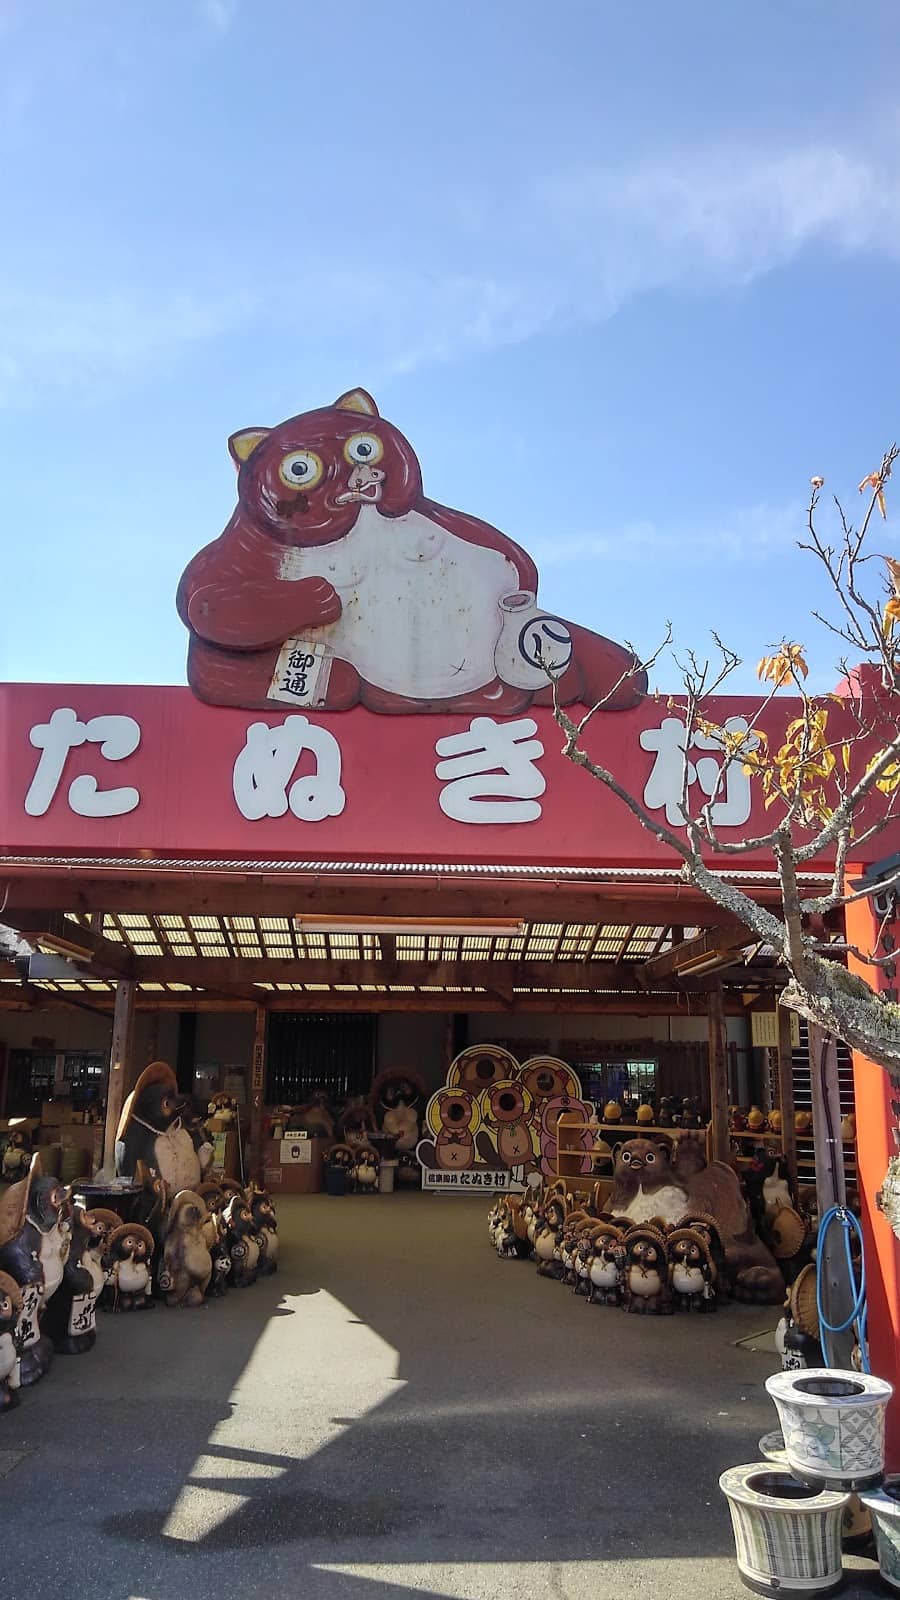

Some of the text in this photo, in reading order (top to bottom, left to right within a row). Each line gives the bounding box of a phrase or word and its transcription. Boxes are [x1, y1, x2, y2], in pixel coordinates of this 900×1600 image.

[279, 650, 315, 697] 御通
[24, 706, 761, 827] たぬき村
